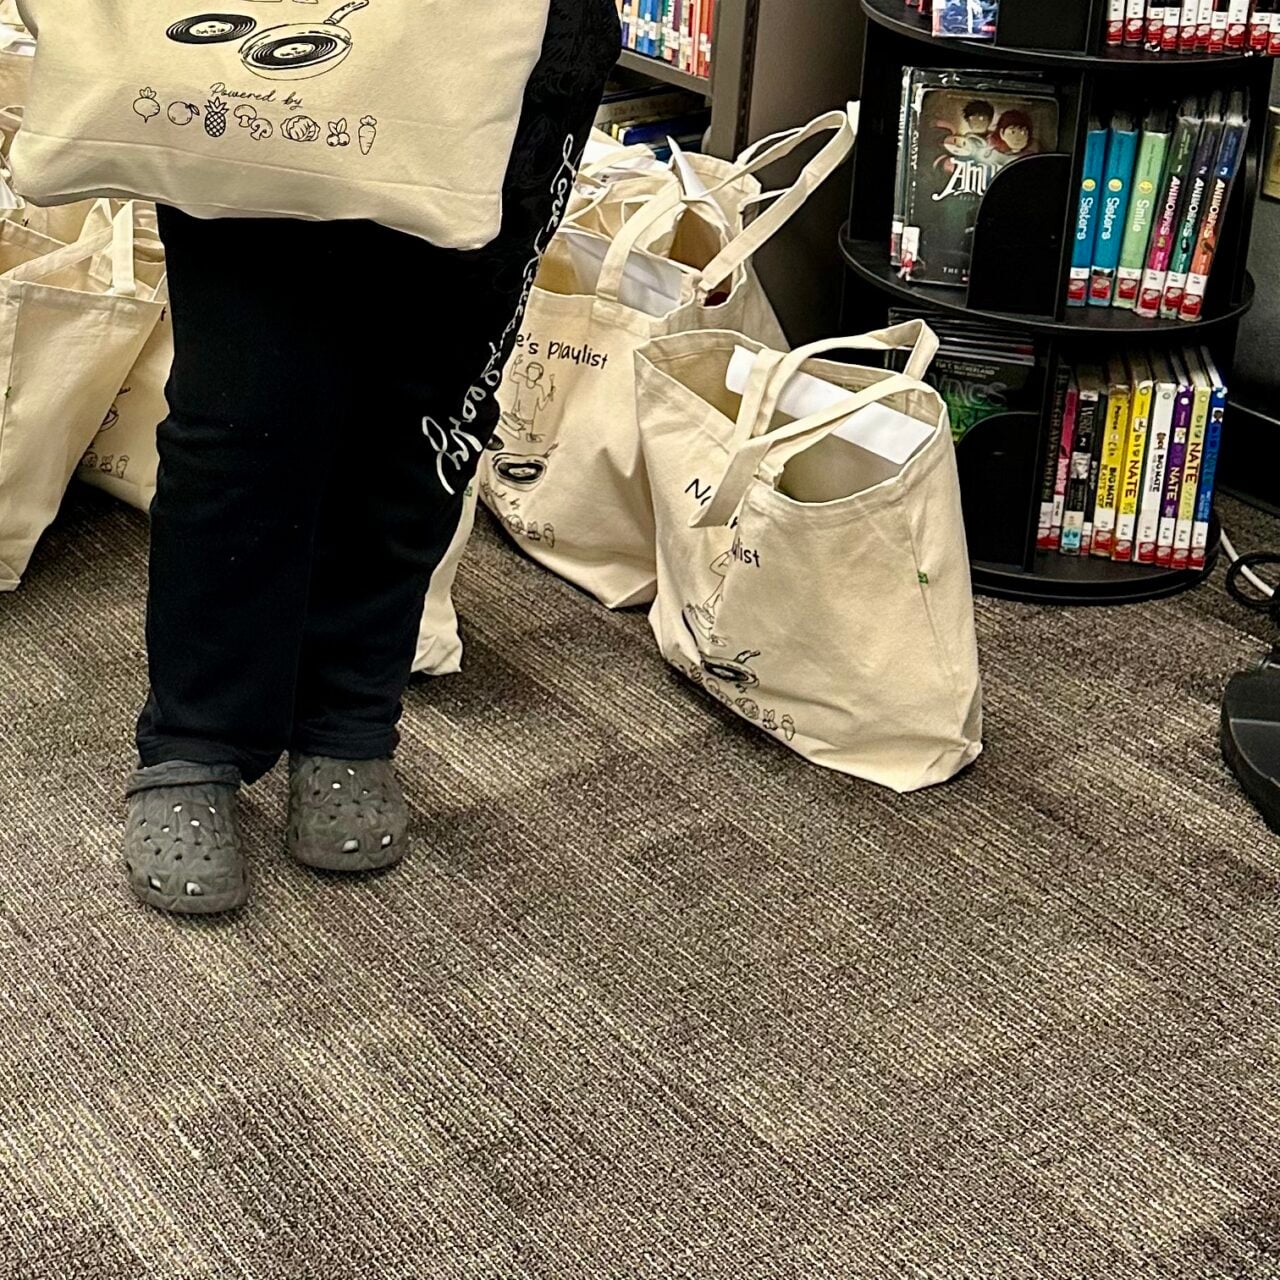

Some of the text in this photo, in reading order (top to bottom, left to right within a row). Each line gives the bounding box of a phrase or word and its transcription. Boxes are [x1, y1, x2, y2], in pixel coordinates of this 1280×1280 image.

[209, 82, 304, 110] Powered by
[1077, 196, 1094, 240] Sisters
[1101, 196, 1120, 240] Sisters
[1132, 199, 1149, 232] Smile
[547, 340, 608, 370] Playlist
[1124, 459, 1140, 499] NATE
[1185, 442, 1201, 484] NATE
[1105, 484, 1115, 508] NATE
[1167, 466, 1181, 500] NATE
